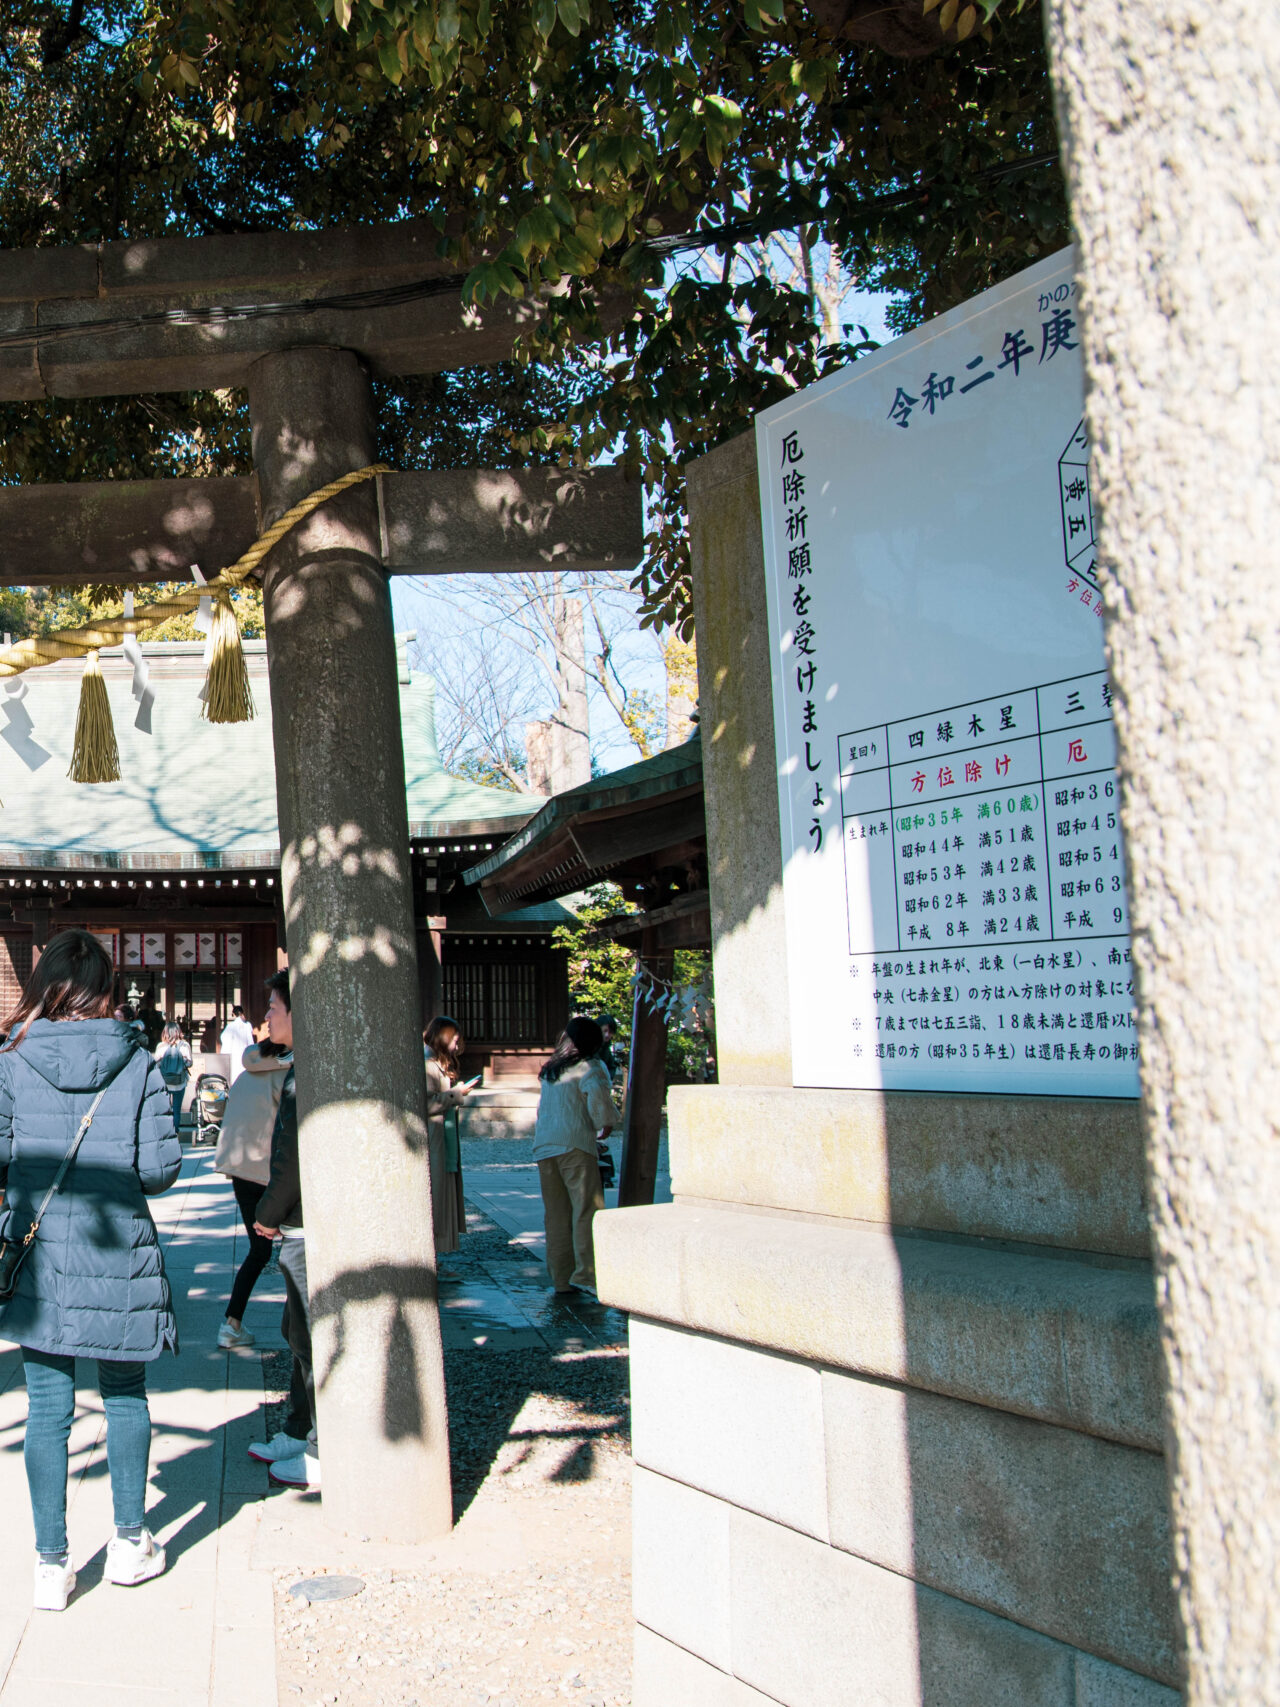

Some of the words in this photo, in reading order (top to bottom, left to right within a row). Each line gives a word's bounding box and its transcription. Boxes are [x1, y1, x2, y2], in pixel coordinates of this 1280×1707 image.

[887, 309, 1080, 428] 令和二年庚
[781, 430, 824, 854] 厄除祈願を受けましょう
[908, 705, 1016, 749] 四緑木星
[849, 742, 877, 761] 星回り
[1066, 738, 1088, 766] 厄
[911, 754, 1011, 793] 方位除け
[849, 821, 888, 840] 生まれ年
[901, 835, 965, 858] 昭和44年
[979, 824, 1034, 848] 満51歳
[903, 864, 966, 886] 昭和53年
[980, 854, 1036, 877] 満42歳
[905, 892, 968, 914] 昭和62年
[982, 884, 1038, 906] 満33歳
[984, 914, 1040, 935] 満24歳
